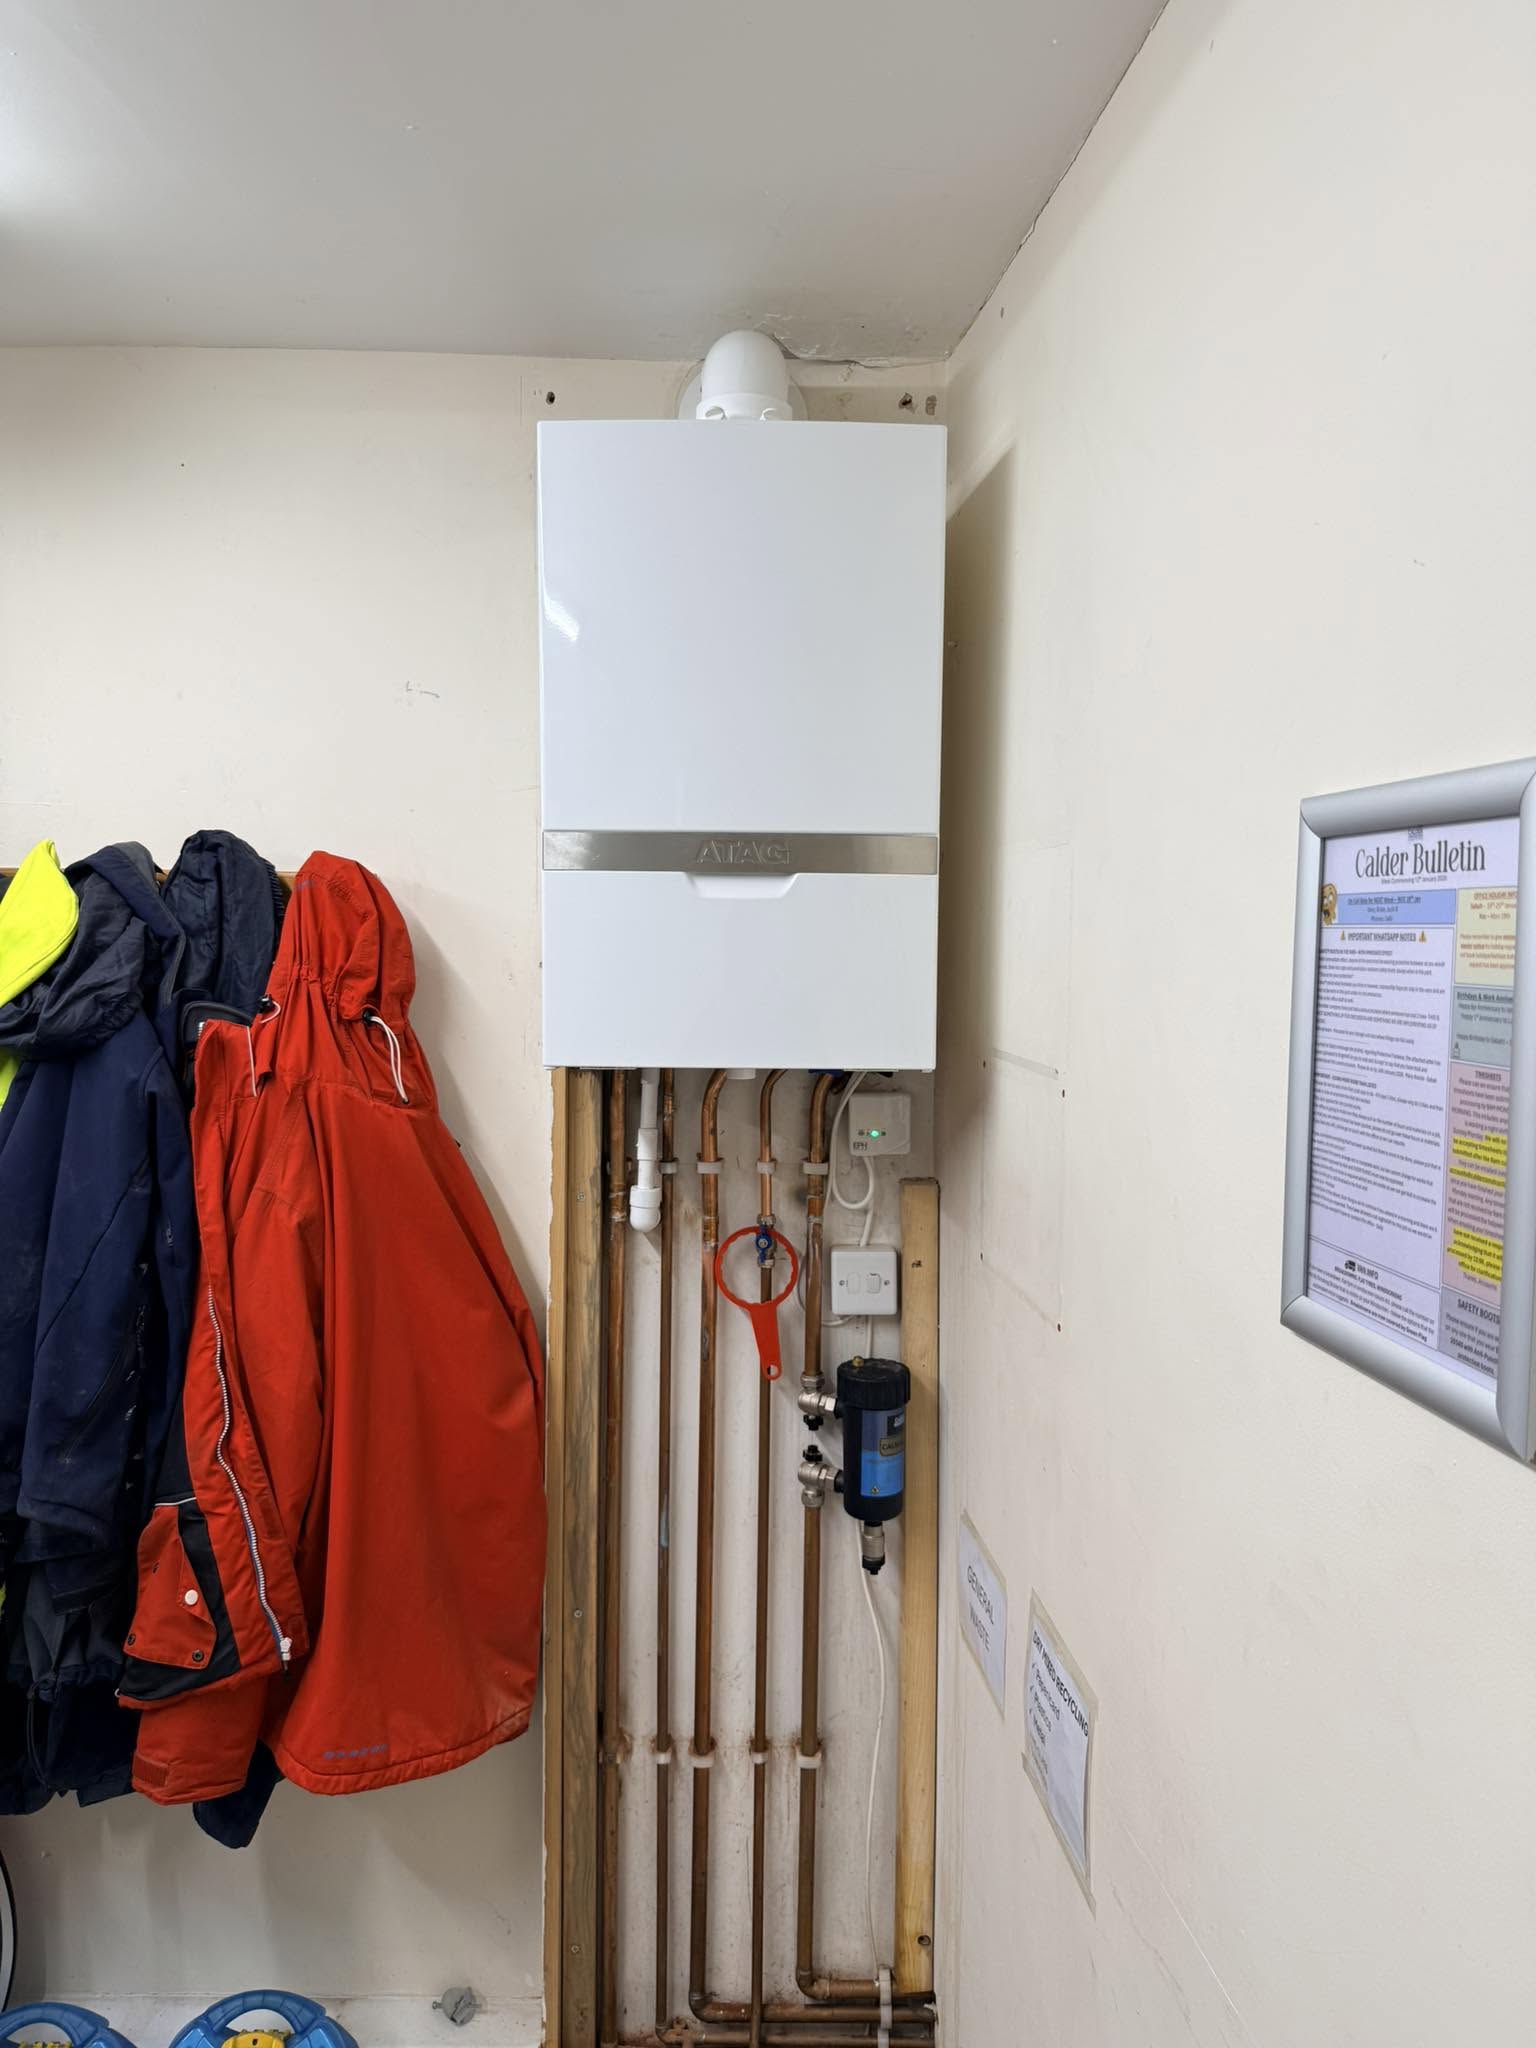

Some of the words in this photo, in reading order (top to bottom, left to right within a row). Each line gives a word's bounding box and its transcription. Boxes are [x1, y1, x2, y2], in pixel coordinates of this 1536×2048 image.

[696, 839, 792, 864] ATAG
[1355, 846, 1408, 878] Calder
[1413, 840, 1485, 875] Bulletin
[1347, 932, 1372, 942] IMPORTANT
[1457, 1297, 1479, 1316] SAFETY
[1479, 1307, 1499, 1325] BOOTS
[967, 1564, 995, 1626] GENERAL
[968, 1601, 991, 1653] WASTE
[1032, 1630, 1043, 1655] DRY
[1041, 1648, 1057, 1683] MIXED
[1055, 1679, 1090, 1738] RECYCLING
